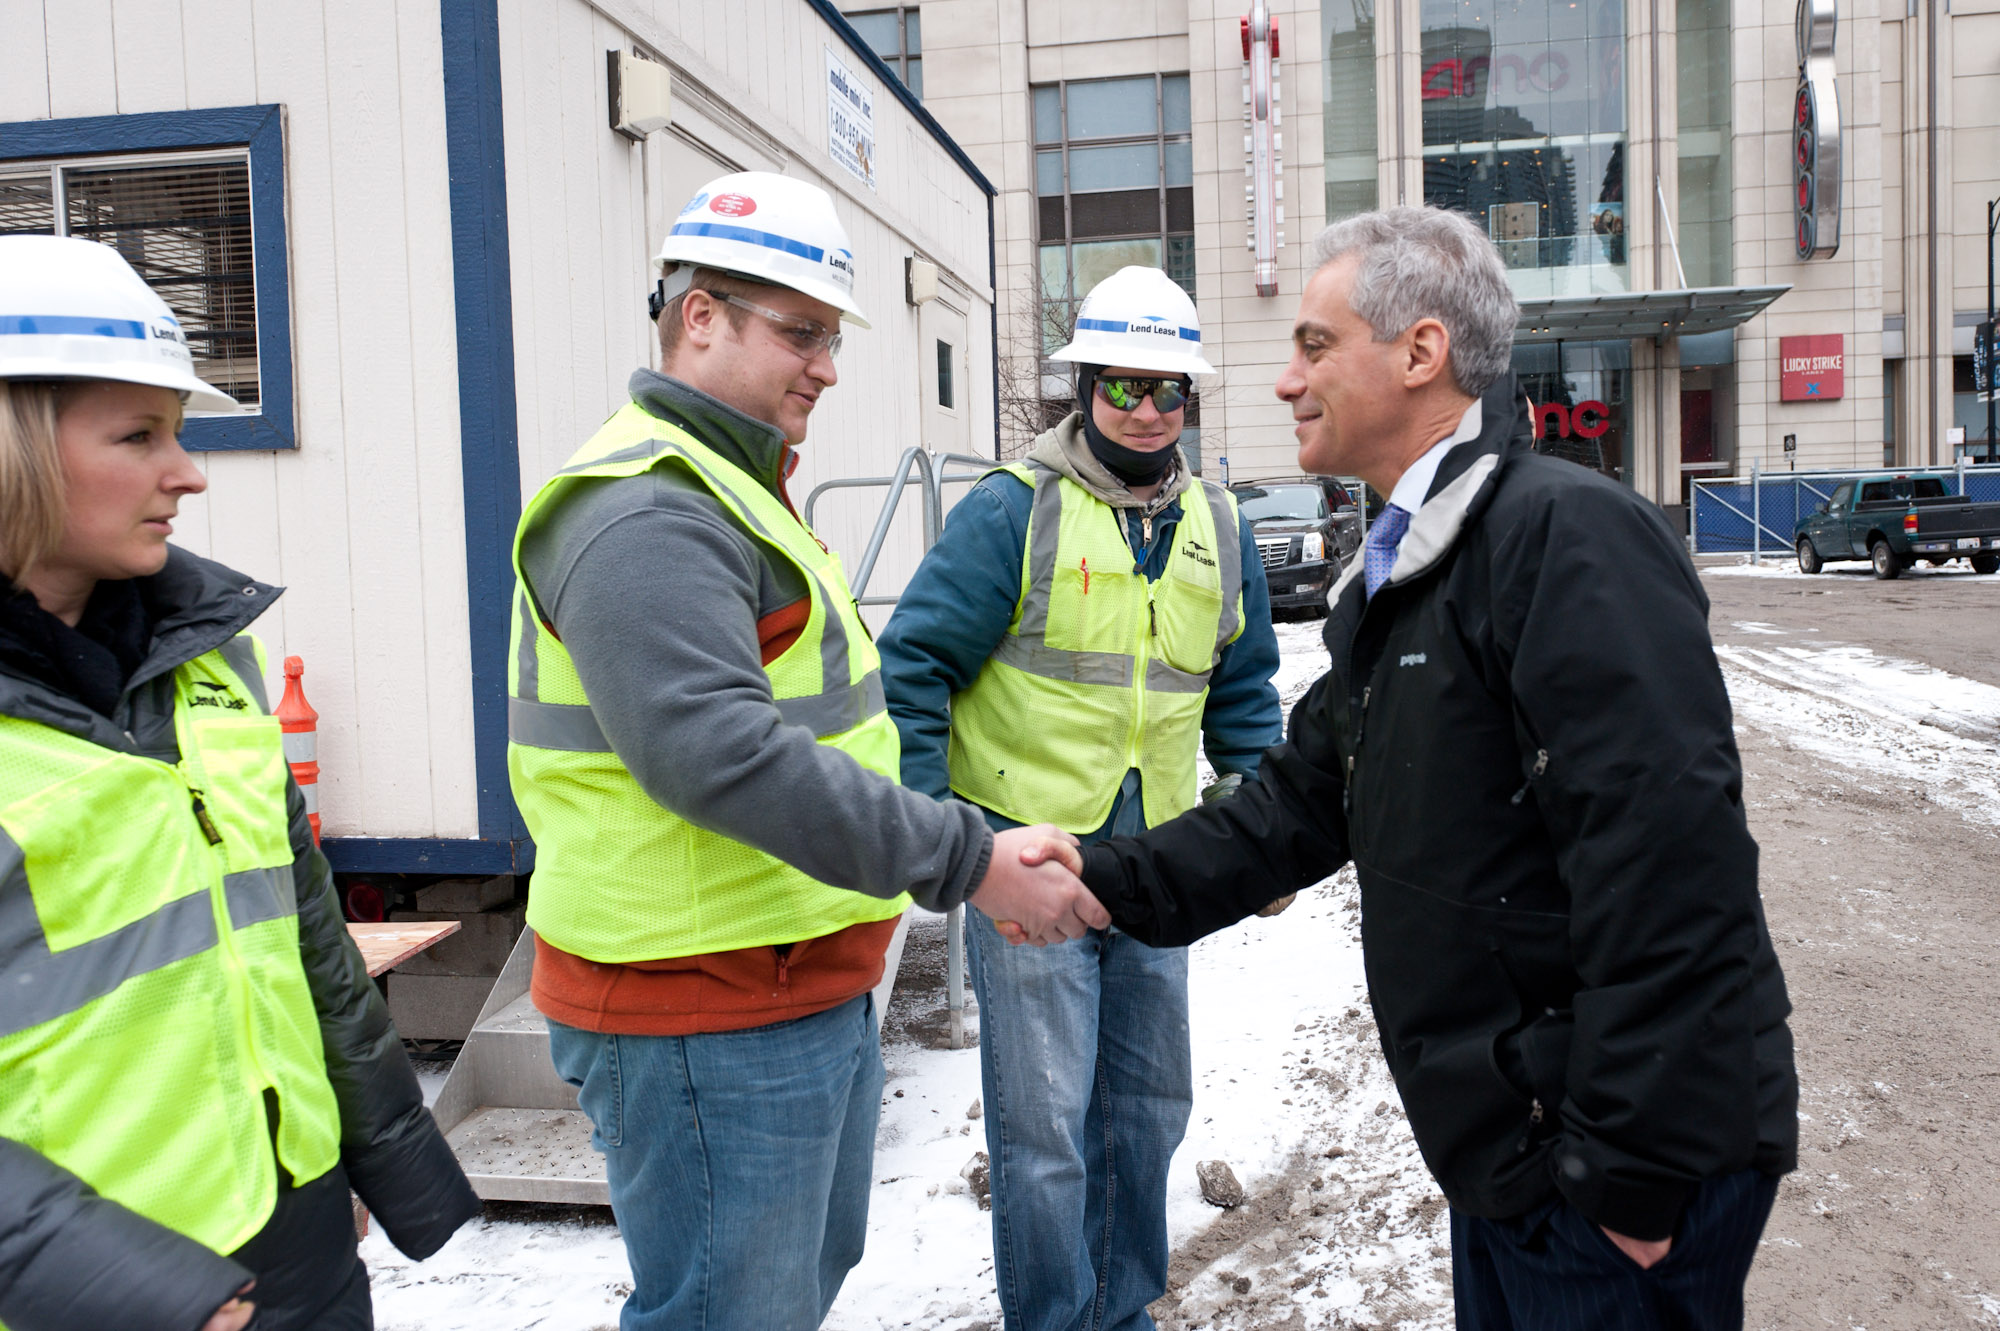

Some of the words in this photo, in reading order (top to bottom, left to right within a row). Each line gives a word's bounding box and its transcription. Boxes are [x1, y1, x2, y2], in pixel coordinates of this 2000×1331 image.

[1421, 51, 1570, 100] amc
[830, 255, 847, 271] Lend
[151, 325, 177, 342] Lend
[1130, 324, 1152, 333] Lend
[1153, 325, 1176, 337] Lease
[1783, 357, 1811, 373] LUCKY
[1812, 354, 1842, 370] STRIKE
[187, 695, 220, 709] Lend
